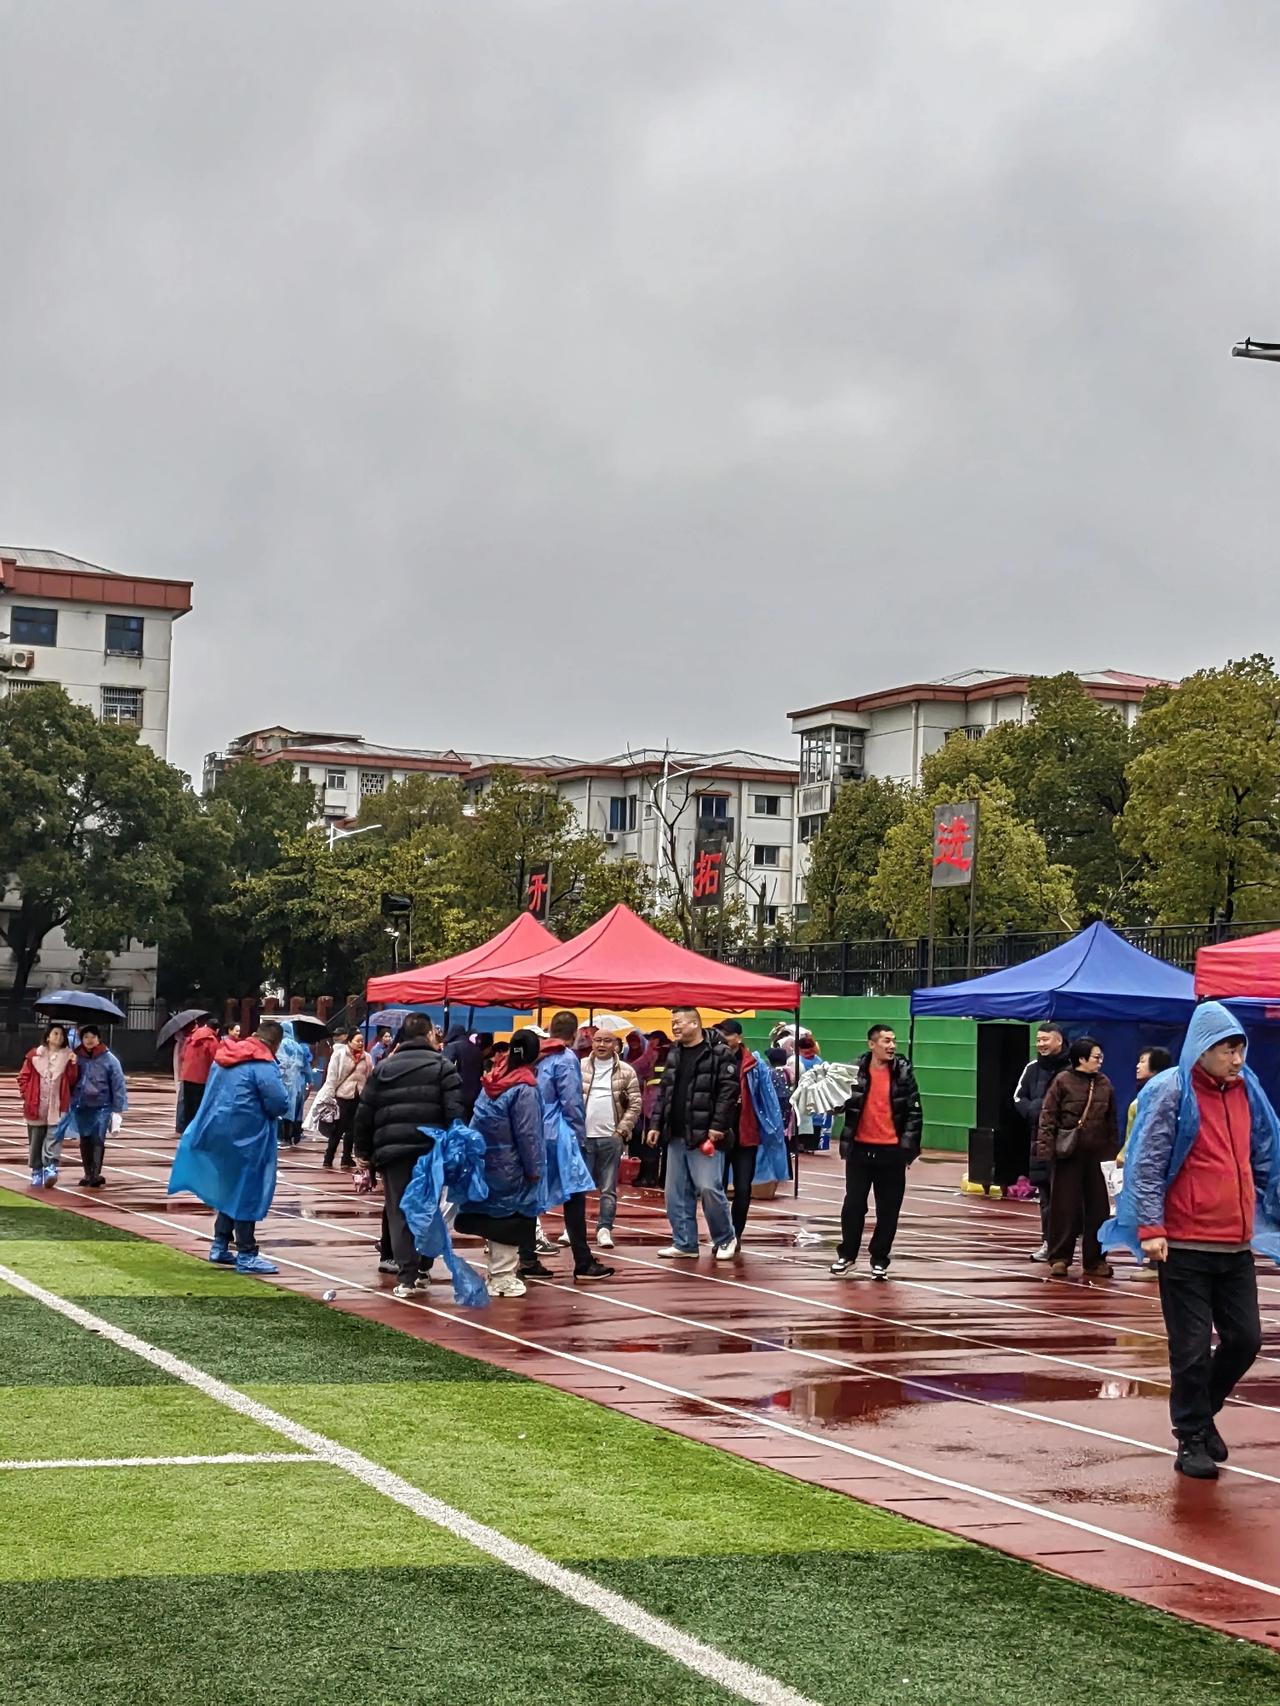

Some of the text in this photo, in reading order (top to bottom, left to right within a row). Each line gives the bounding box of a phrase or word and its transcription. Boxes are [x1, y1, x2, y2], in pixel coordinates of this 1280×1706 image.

[933, 815, 972, 872] 进
[528, 873, 548, 911] 开
[693, 850, 722, 897] 拓
